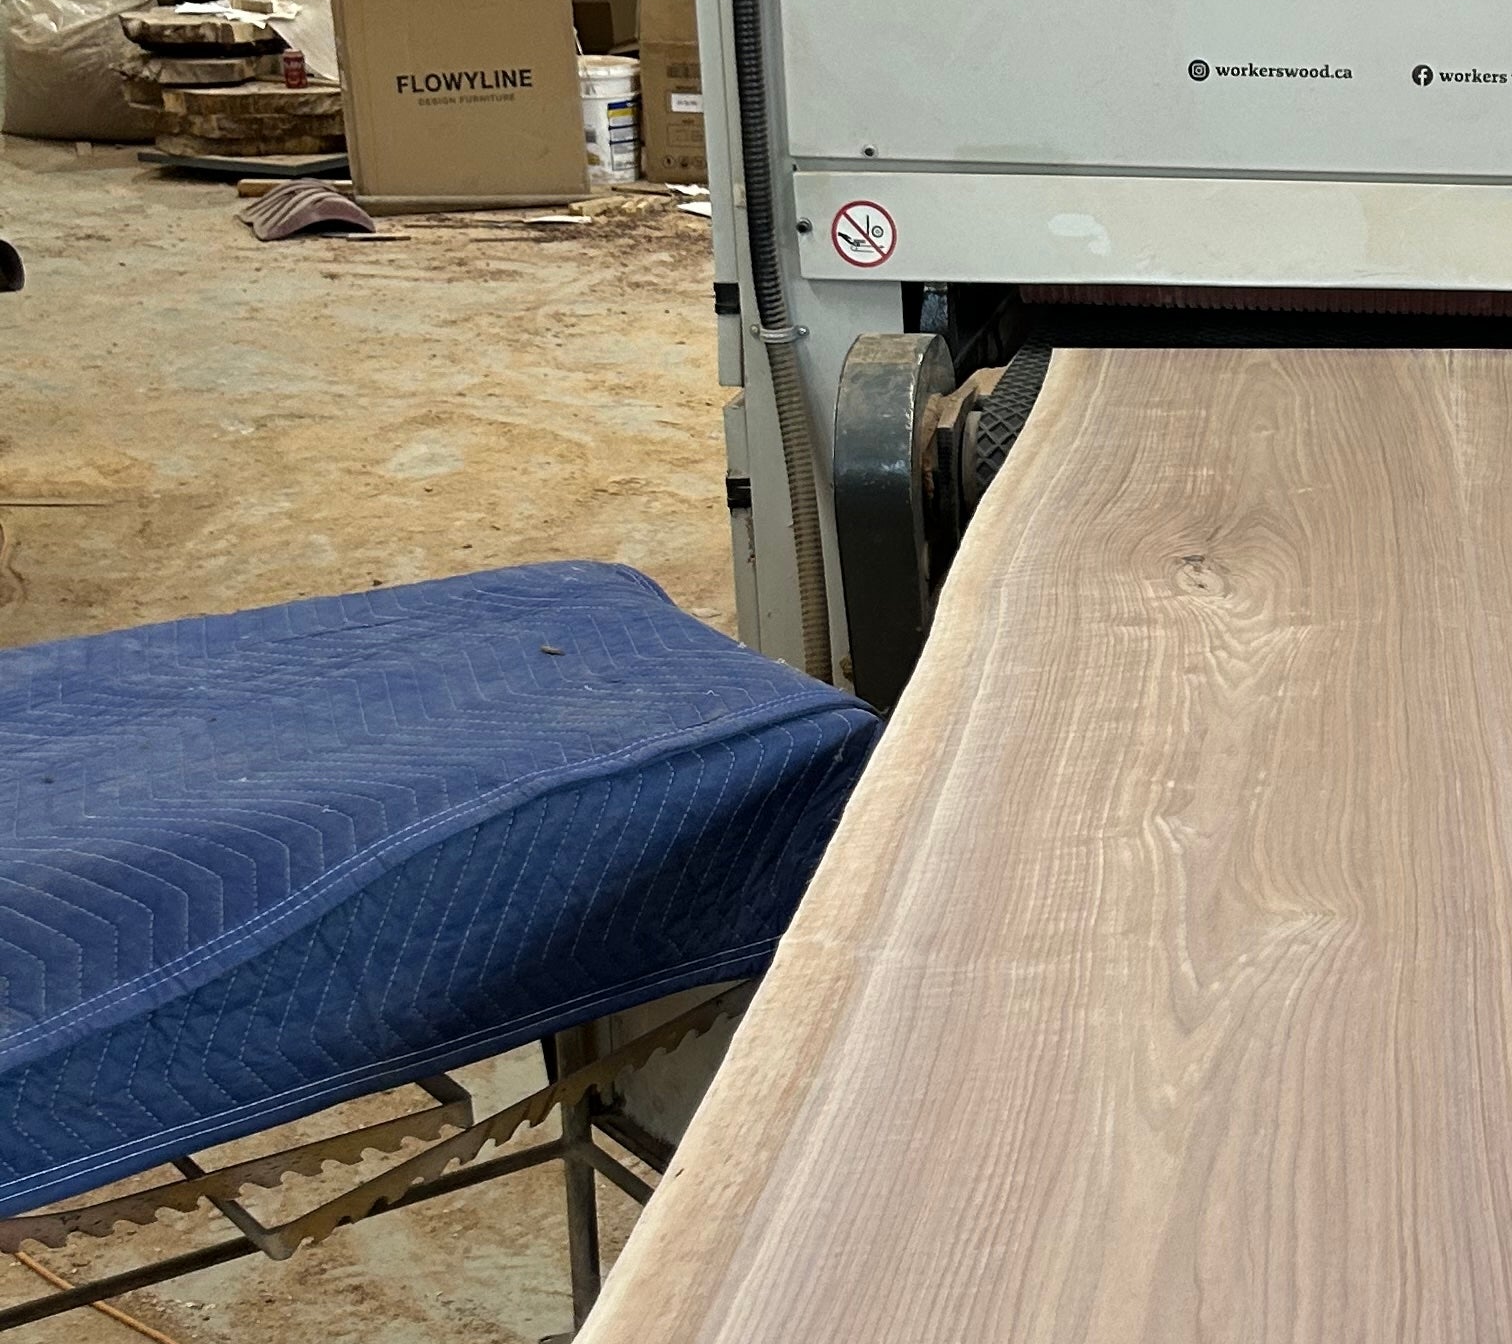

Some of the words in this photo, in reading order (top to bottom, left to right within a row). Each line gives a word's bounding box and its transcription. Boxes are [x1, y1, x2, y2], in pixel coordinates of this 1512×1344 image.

[1215, 62, 1353, 79] workerswood.ca
[1438, 68, 1508, 84] workers
[396, 69, 533, 94] FLOWYLINE
[418, 96, 456, 106] DESIGN
[459, 93, 515, 104] FURNITURE
